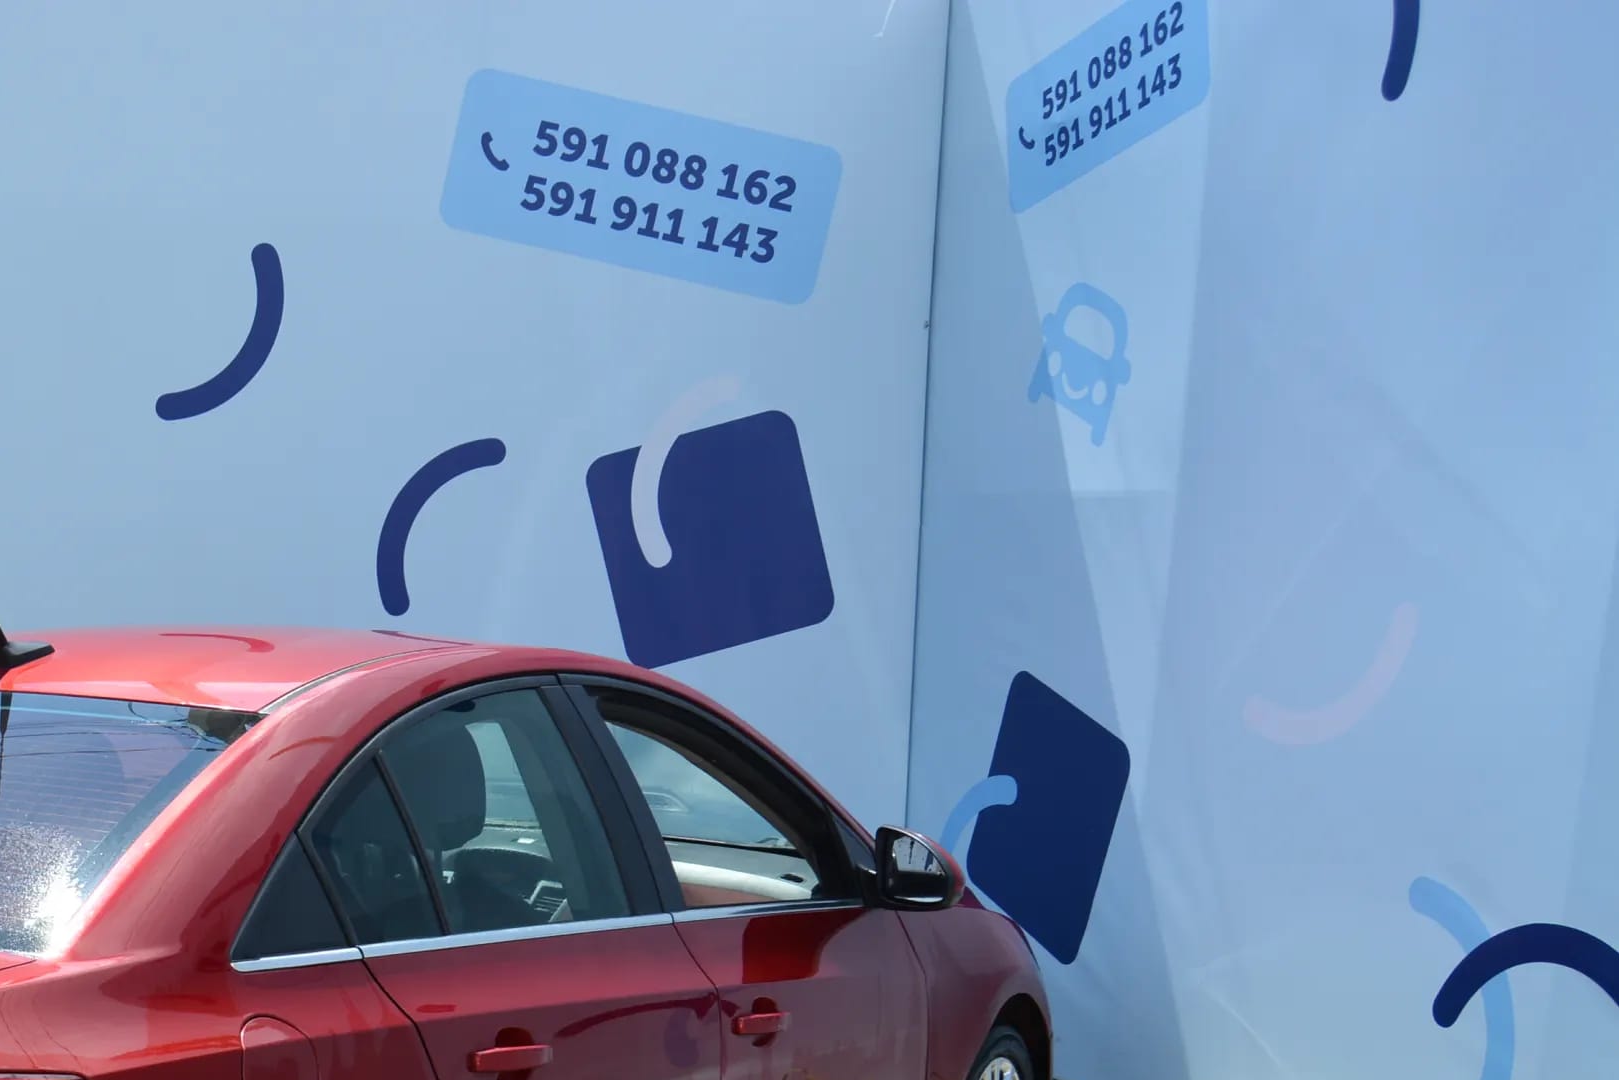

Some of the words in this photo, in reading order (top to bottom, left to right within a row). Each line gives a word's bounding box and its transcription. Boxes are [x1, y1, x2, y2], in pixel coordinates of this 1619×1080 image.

[1041, 69, 1082, 121] 591
[1087, 35, 1133, 90] 088
[1138, 0, 1185, 59] 162
[1043, 117, 1085, 168] 591
[1088, 86, 1132, 140] 911
[1136, 52, 1183, 111] 143
[519, 174, 599, 225] 591
[609, 195, 687, 246] 911
[696, 215, 780, 264] 143
[532, 119, 610, 171] 591
[623, 141, 708, 192] 088
[715, 163, 798, 214] 162
